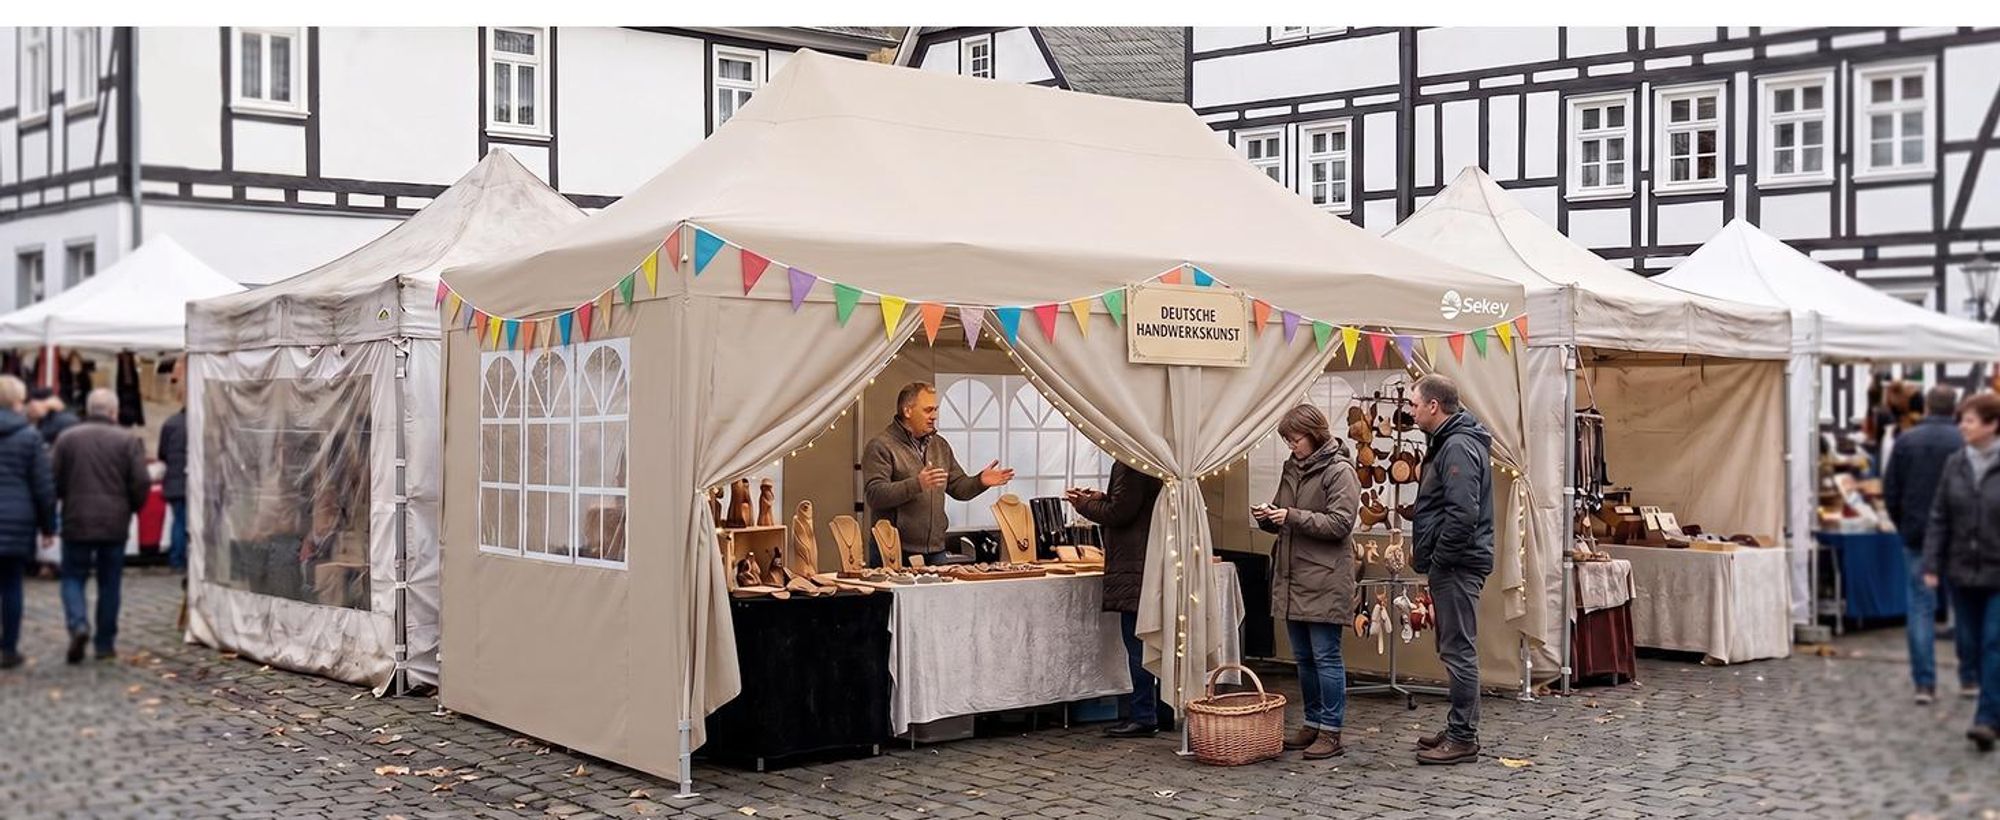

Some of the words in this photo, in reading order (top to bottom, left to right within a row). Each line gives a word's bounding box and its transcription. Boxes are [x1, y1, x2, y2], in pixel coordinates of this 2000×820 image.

[1161, 306, 1216, 322] DEUTSCHE
[1461, 297, 1509, 318] Sekey
[1136, 322, 1240, 341] HANDWERKSKUNST
